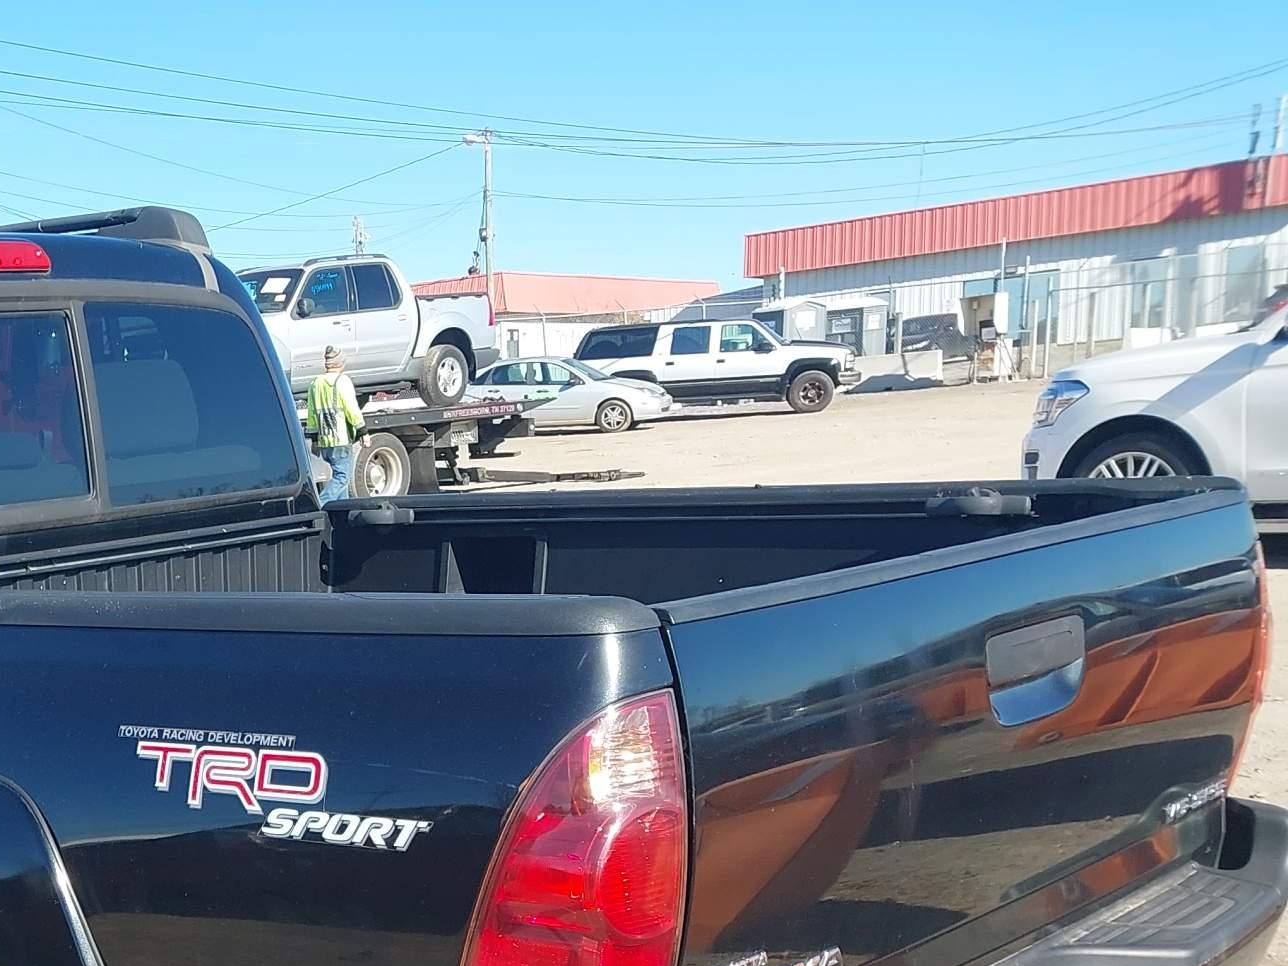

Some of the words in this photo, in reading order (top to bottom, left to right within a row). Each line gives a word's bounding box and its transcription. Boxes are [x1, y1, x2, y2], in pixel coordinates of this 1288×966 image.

[118, 725, 159, 740] TOYOTA
[162, 728, 205, 742] RACING
[207, 731, 296, 748] DEVELOPMENT
[136, 741, 328, 815] TRD
[261, 808, 434, 852] SPORT
